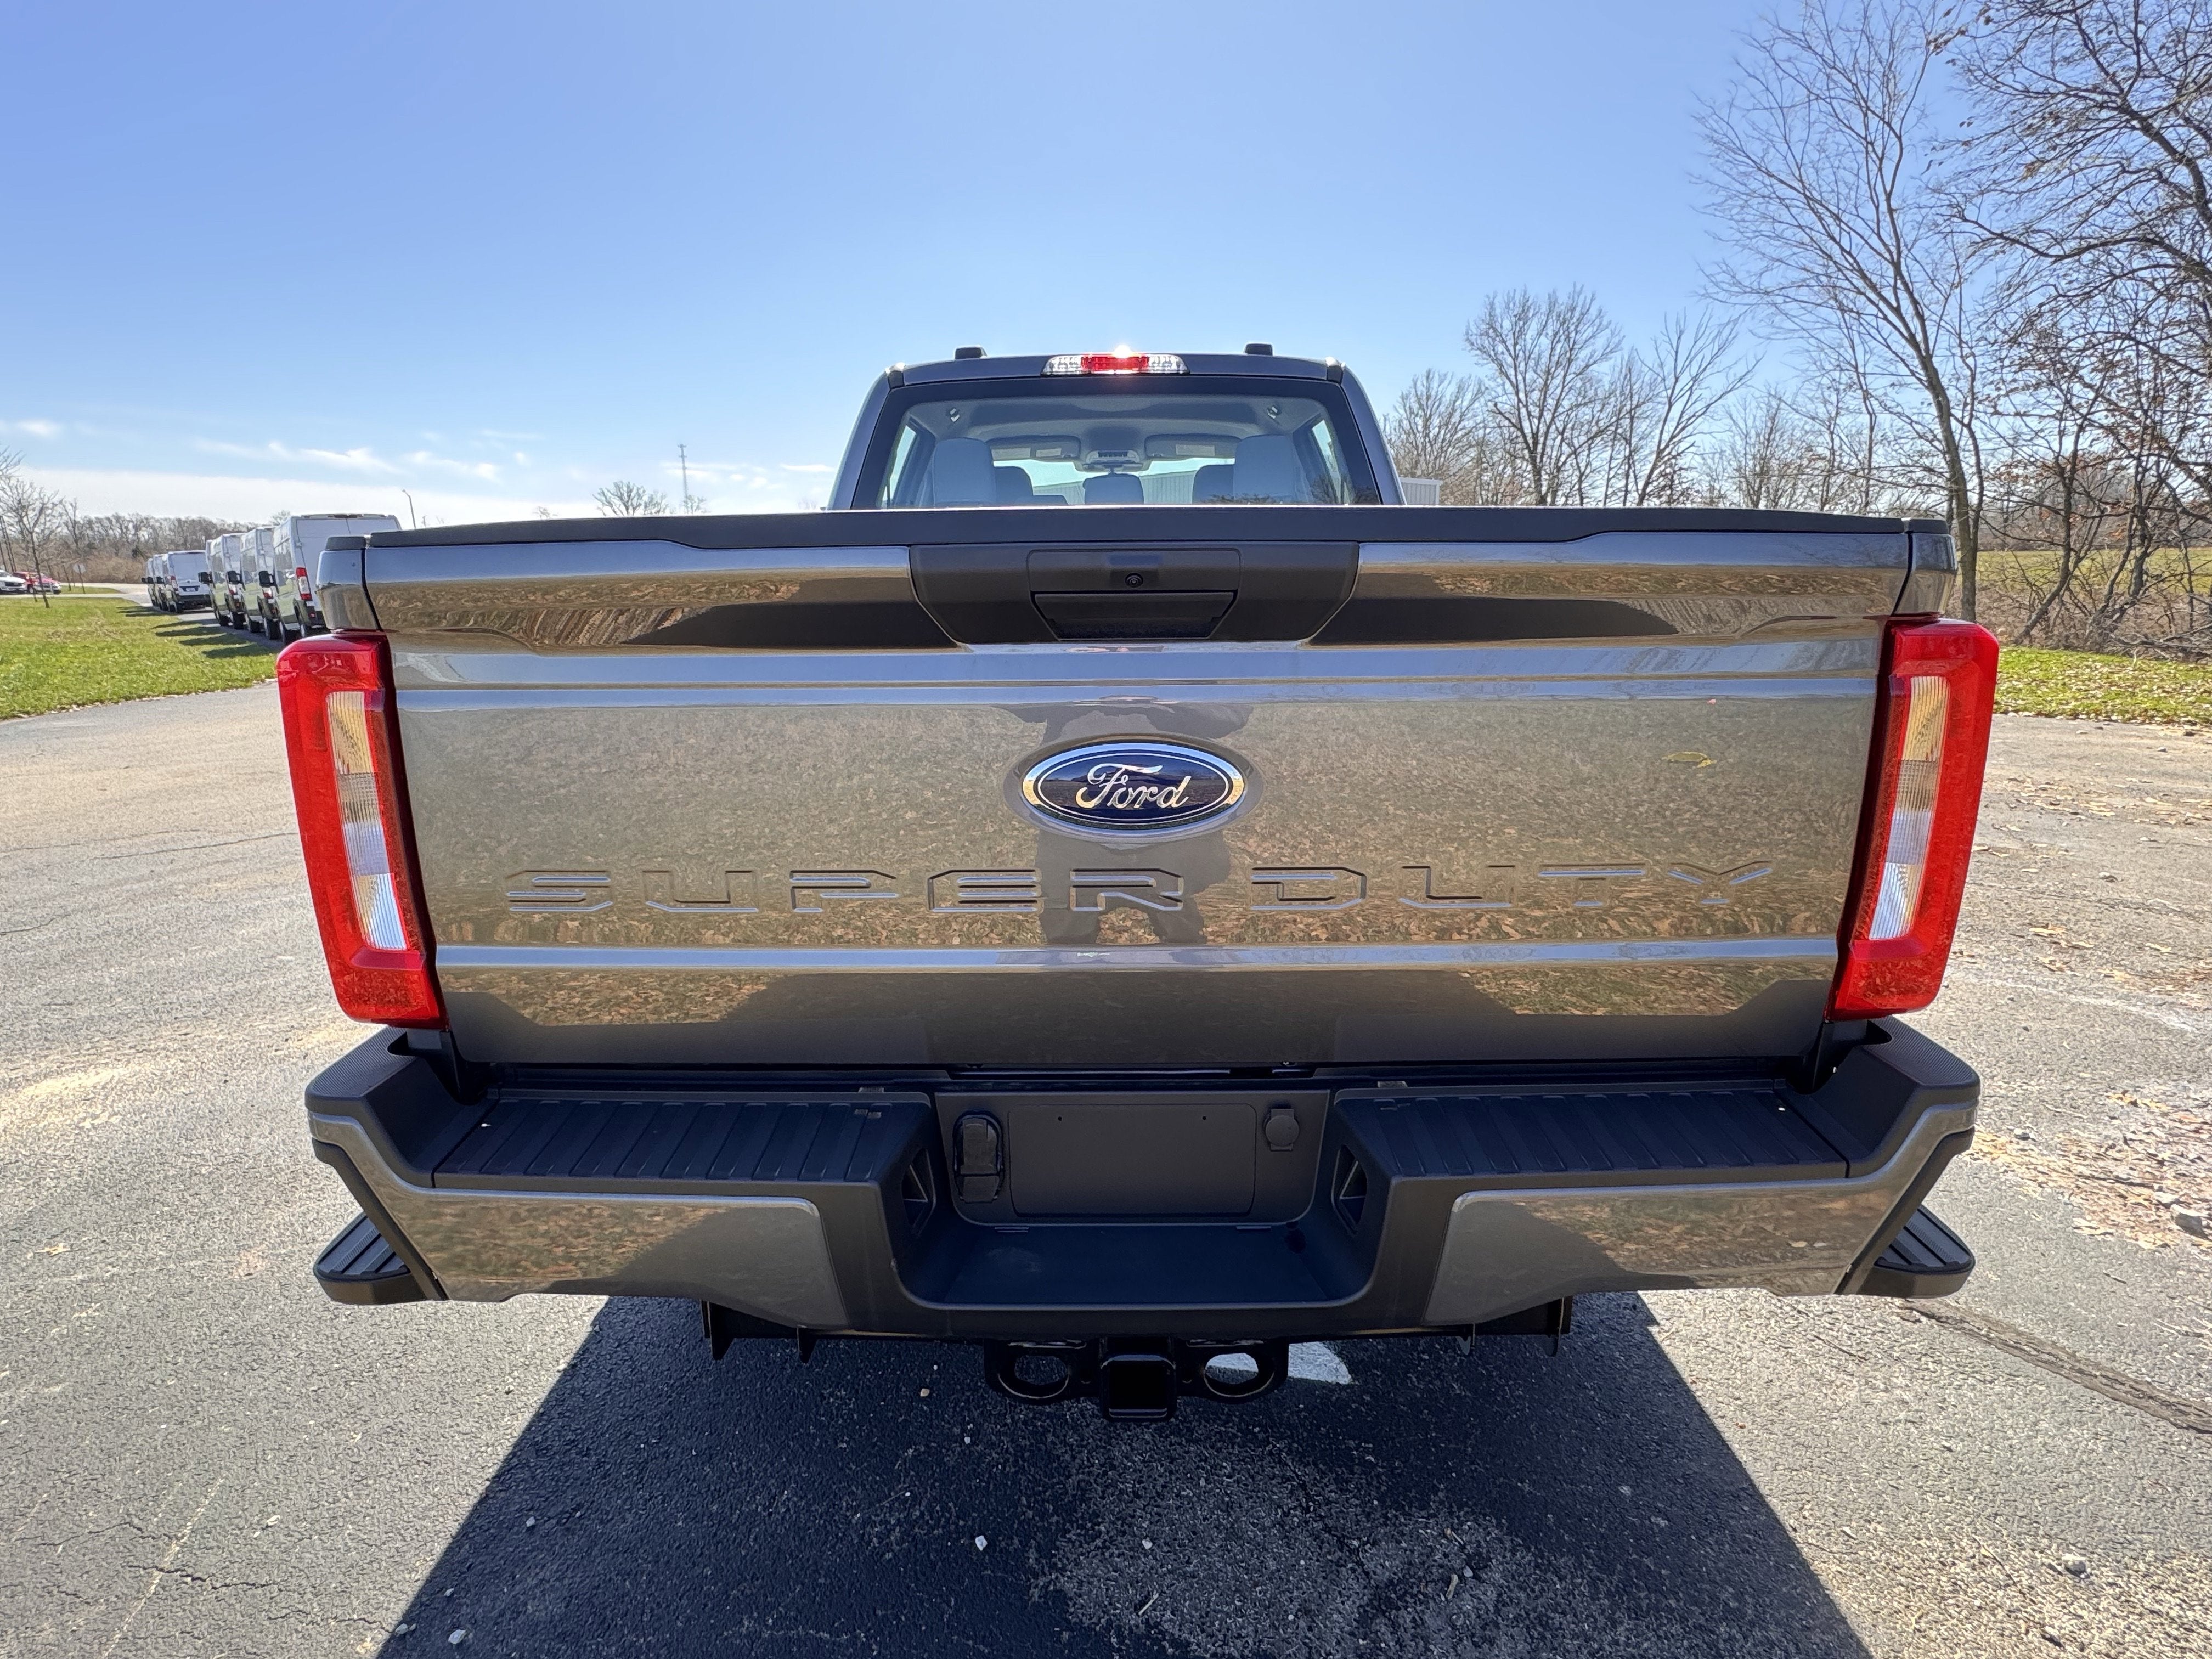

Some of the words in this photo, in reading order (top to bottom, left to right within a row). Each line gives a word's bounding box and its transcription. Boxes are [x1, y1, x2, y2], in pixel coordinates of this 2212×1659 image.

[1075, 763, 1192, 809] Ford
[505, 868, 1184, 912] SUPER
[1249, 860, 1774, 911] DUTY
